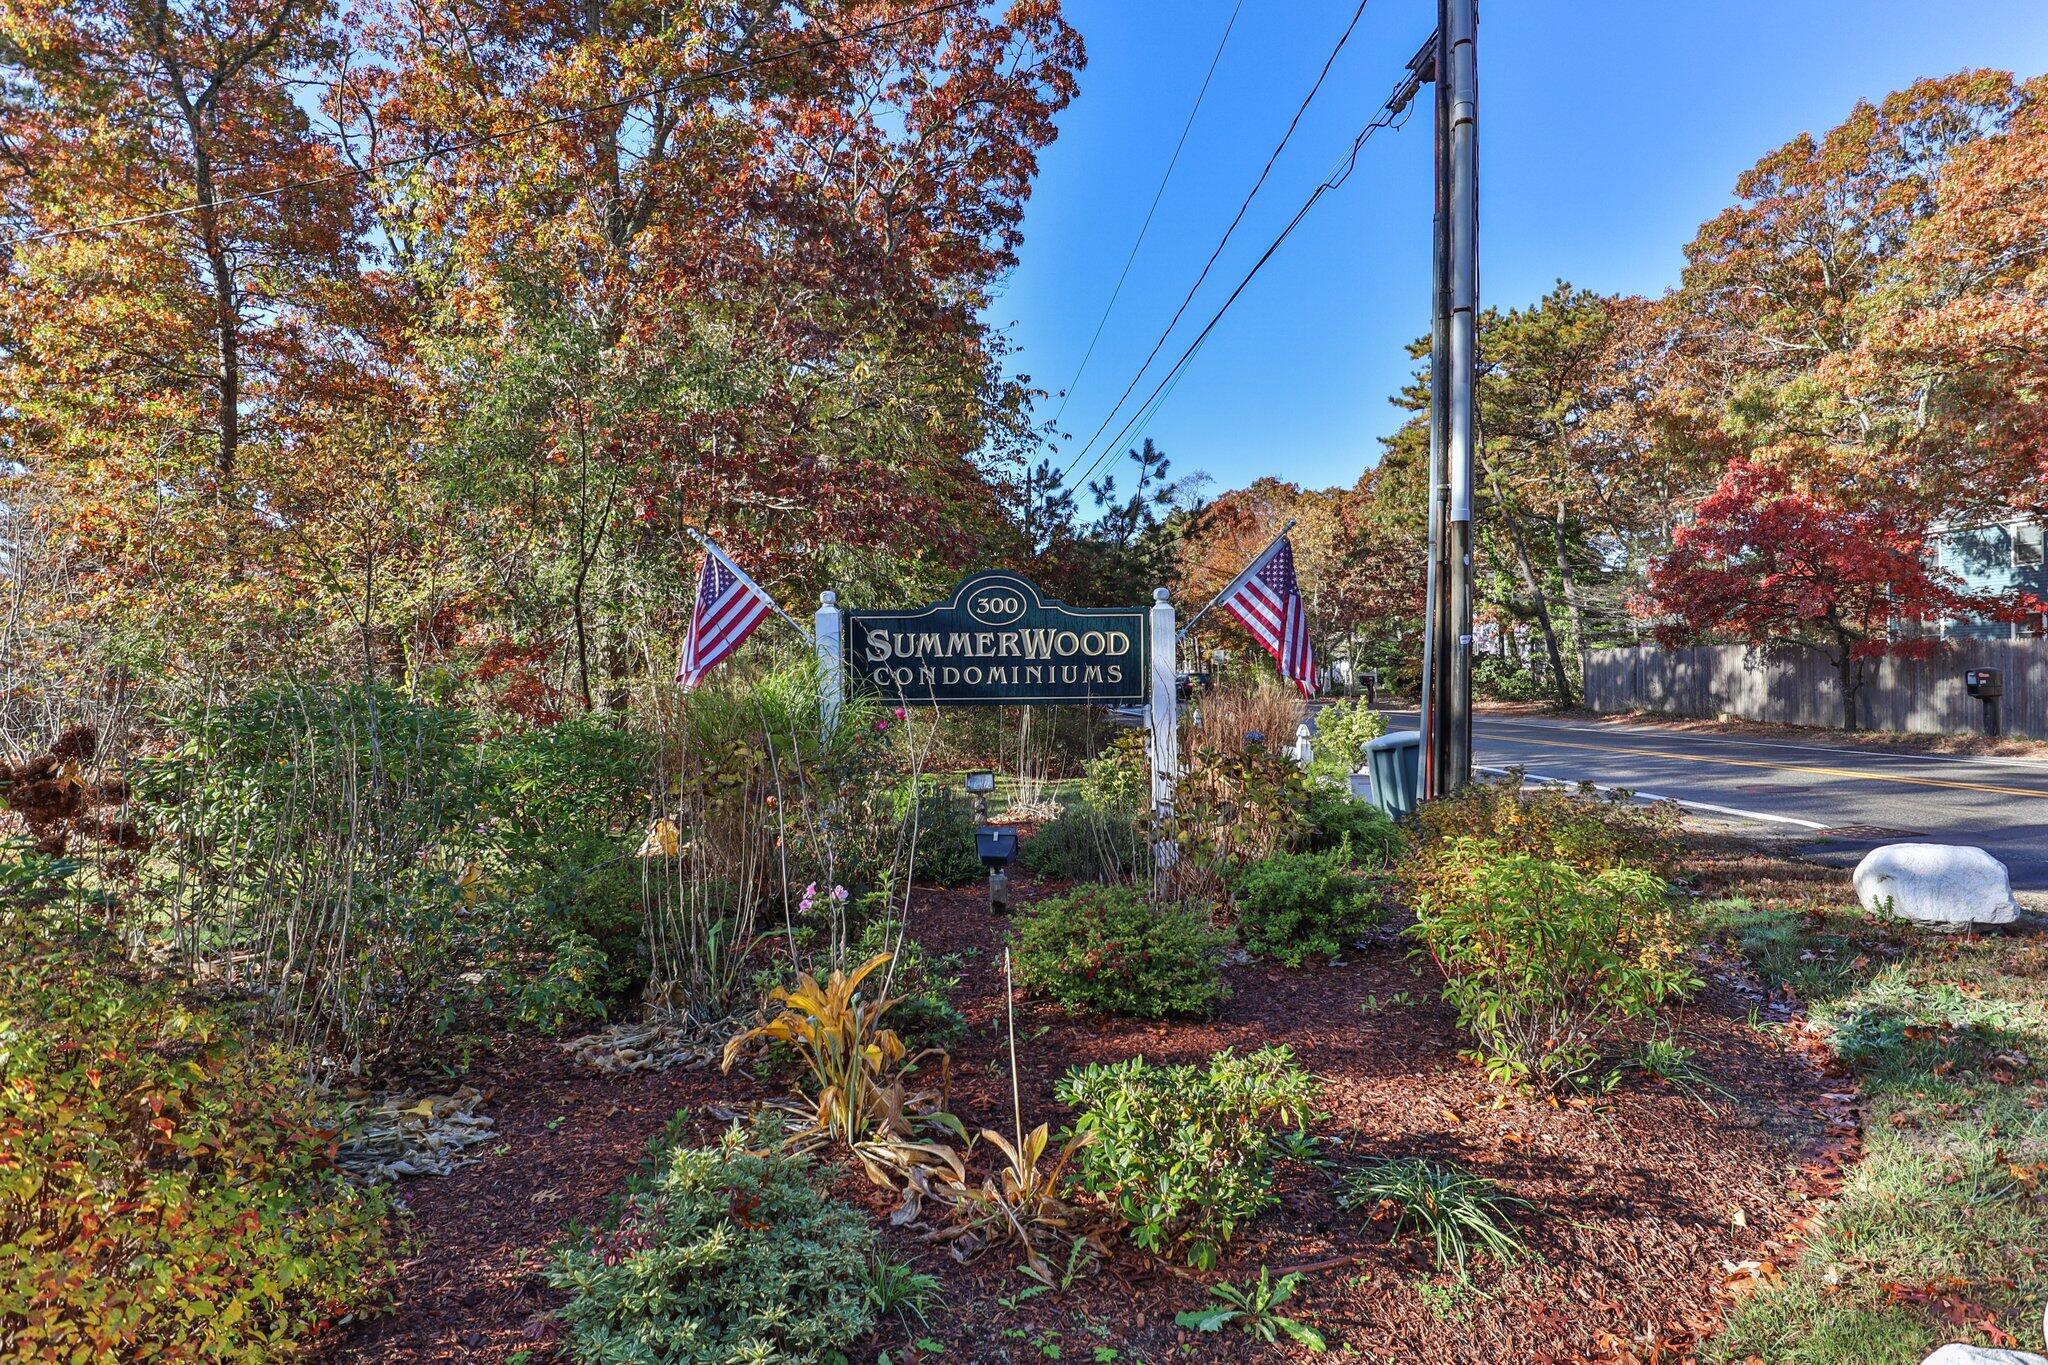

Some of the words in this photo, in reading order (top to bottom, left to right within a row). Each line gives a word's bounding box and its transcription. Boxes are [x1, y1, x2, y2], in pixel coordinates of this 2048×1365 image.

[976, 597, 1019, 614] 300
[865, 628, 1131, 662] SUMMERWOOD
[873, 664, 1123, 686] CONDOMINIUMS
